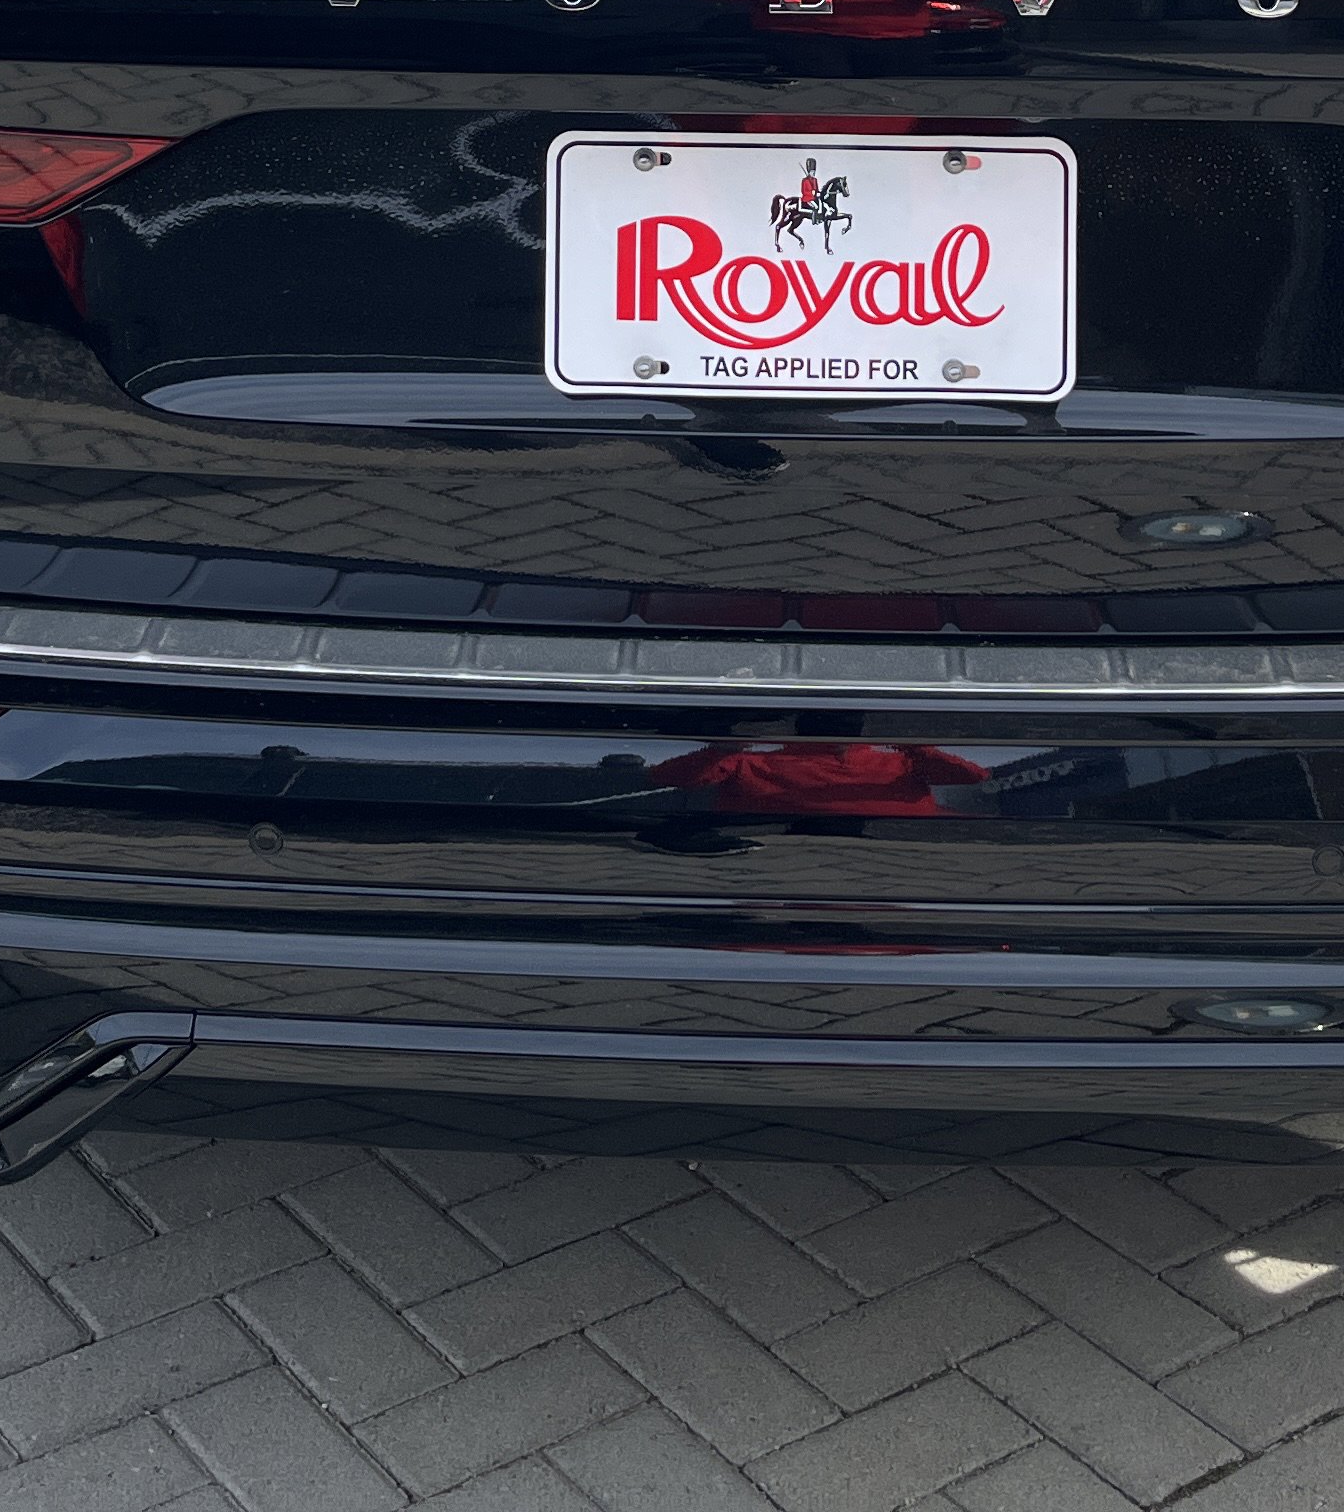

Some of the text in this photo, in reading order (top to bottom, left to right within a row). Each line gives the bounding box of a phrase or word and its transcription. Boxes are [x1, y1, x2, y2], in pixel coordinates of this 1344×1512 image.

[616, 215, 1005, 350] Royal
[700, 356, 919, 380] TAG APPLIED FOR
